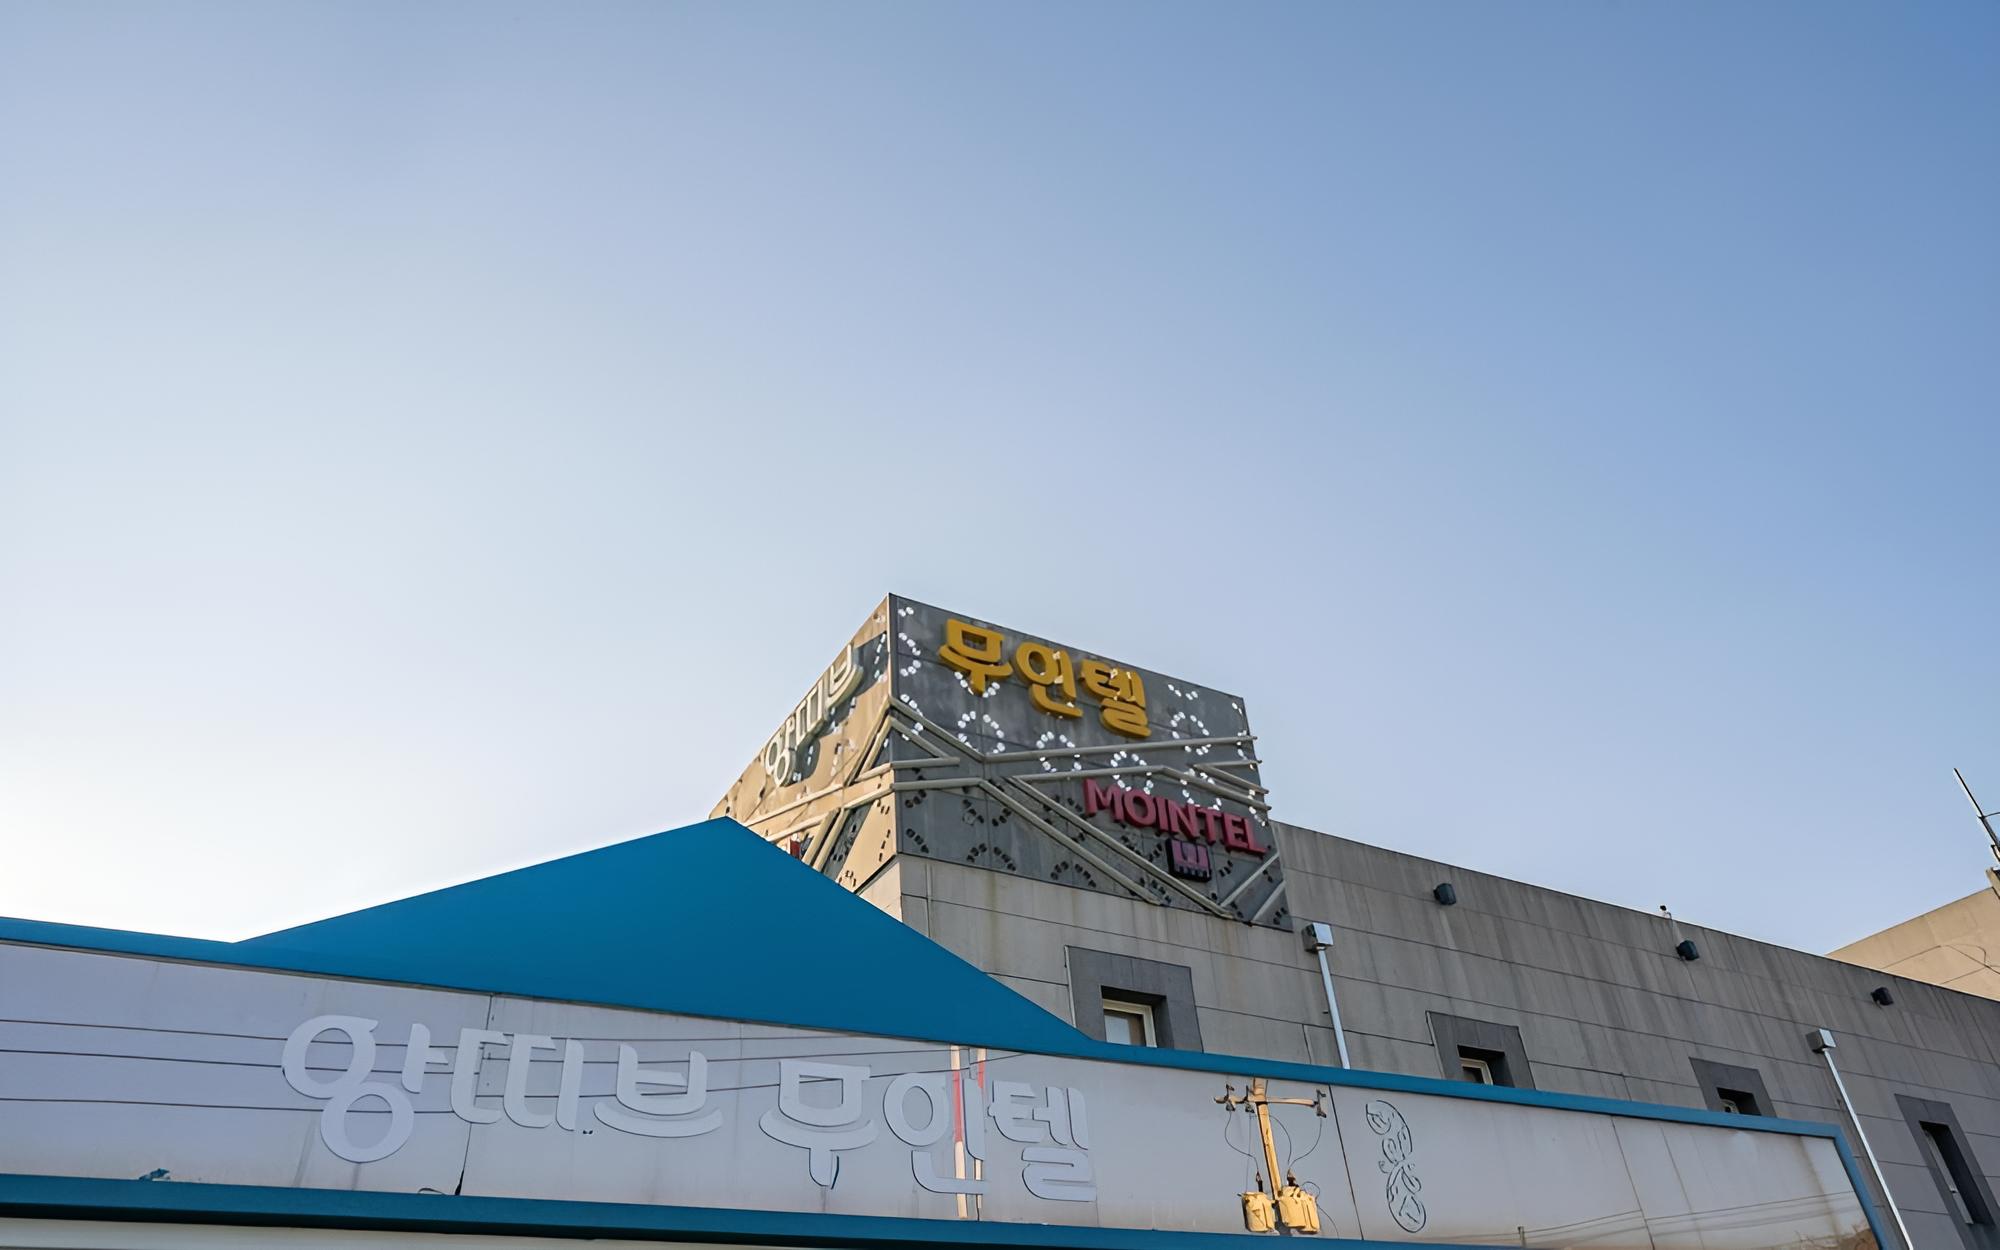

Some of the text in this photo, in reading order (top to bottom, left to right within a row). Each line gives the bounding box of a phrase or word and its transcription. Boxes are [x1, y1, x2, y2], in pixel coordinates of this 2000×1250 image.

[940, 619, 1151, 737] 무인텔
[1083, 778, 1266, 855] MOINTEL
[281, 1014, 1097, 1202] 앙띠브 무인텔
